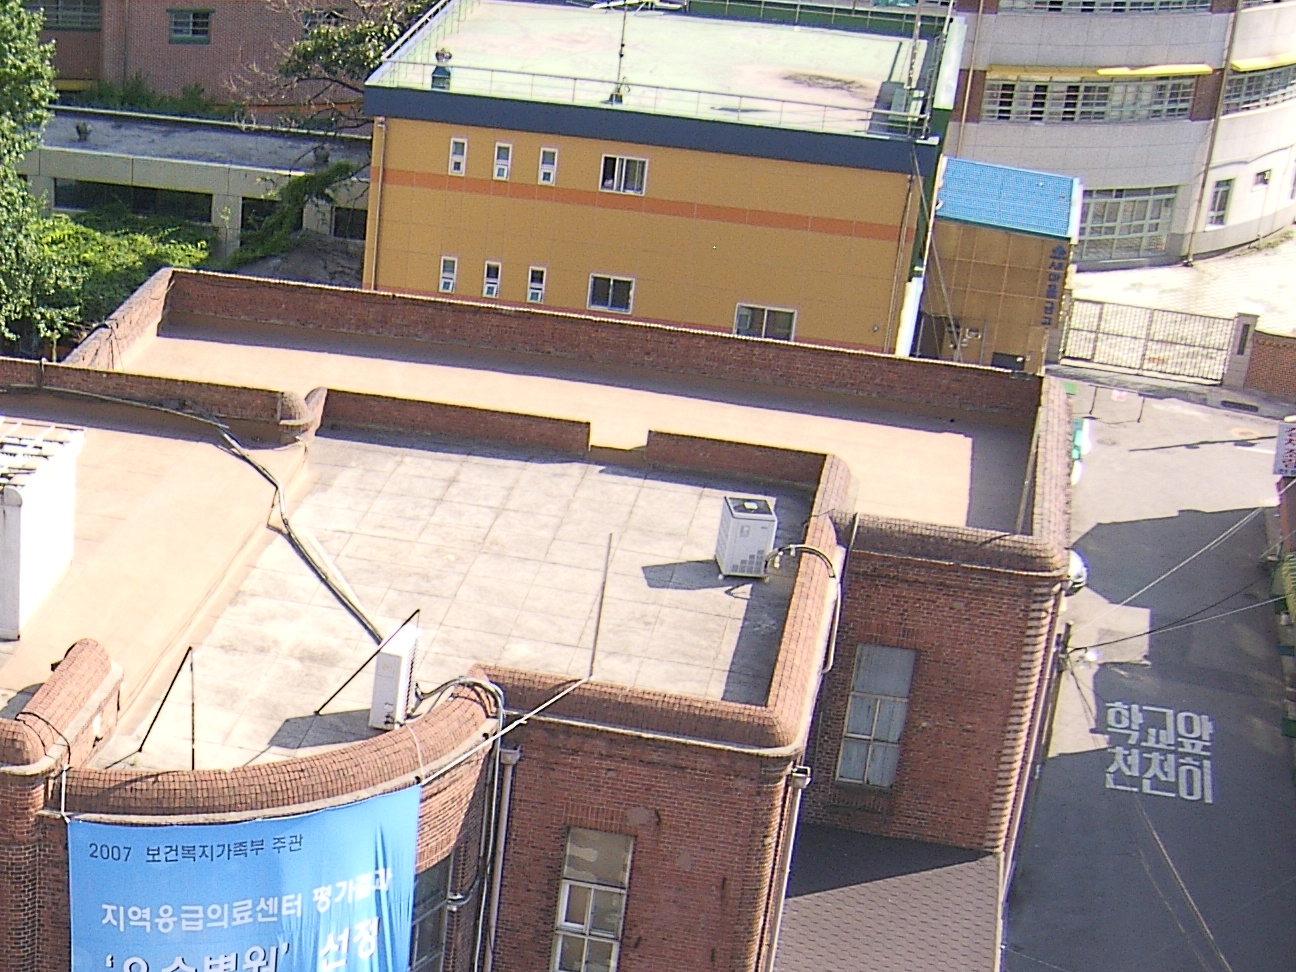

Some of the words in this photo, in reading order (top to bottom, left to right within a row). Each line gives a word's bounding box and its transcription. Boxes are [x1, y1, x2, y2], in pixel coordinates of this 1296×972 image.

[1105, 700, 1214, 757] 학교앞
[1105, 746, 1214, 804] 천천히
[89, 842, 132, 862] 2007
[146, 839, 266, 863] 보건복지가족부
[272, 834, 304, 854] 주관
[101, 893, 303, 933] 지역응급의료센터
